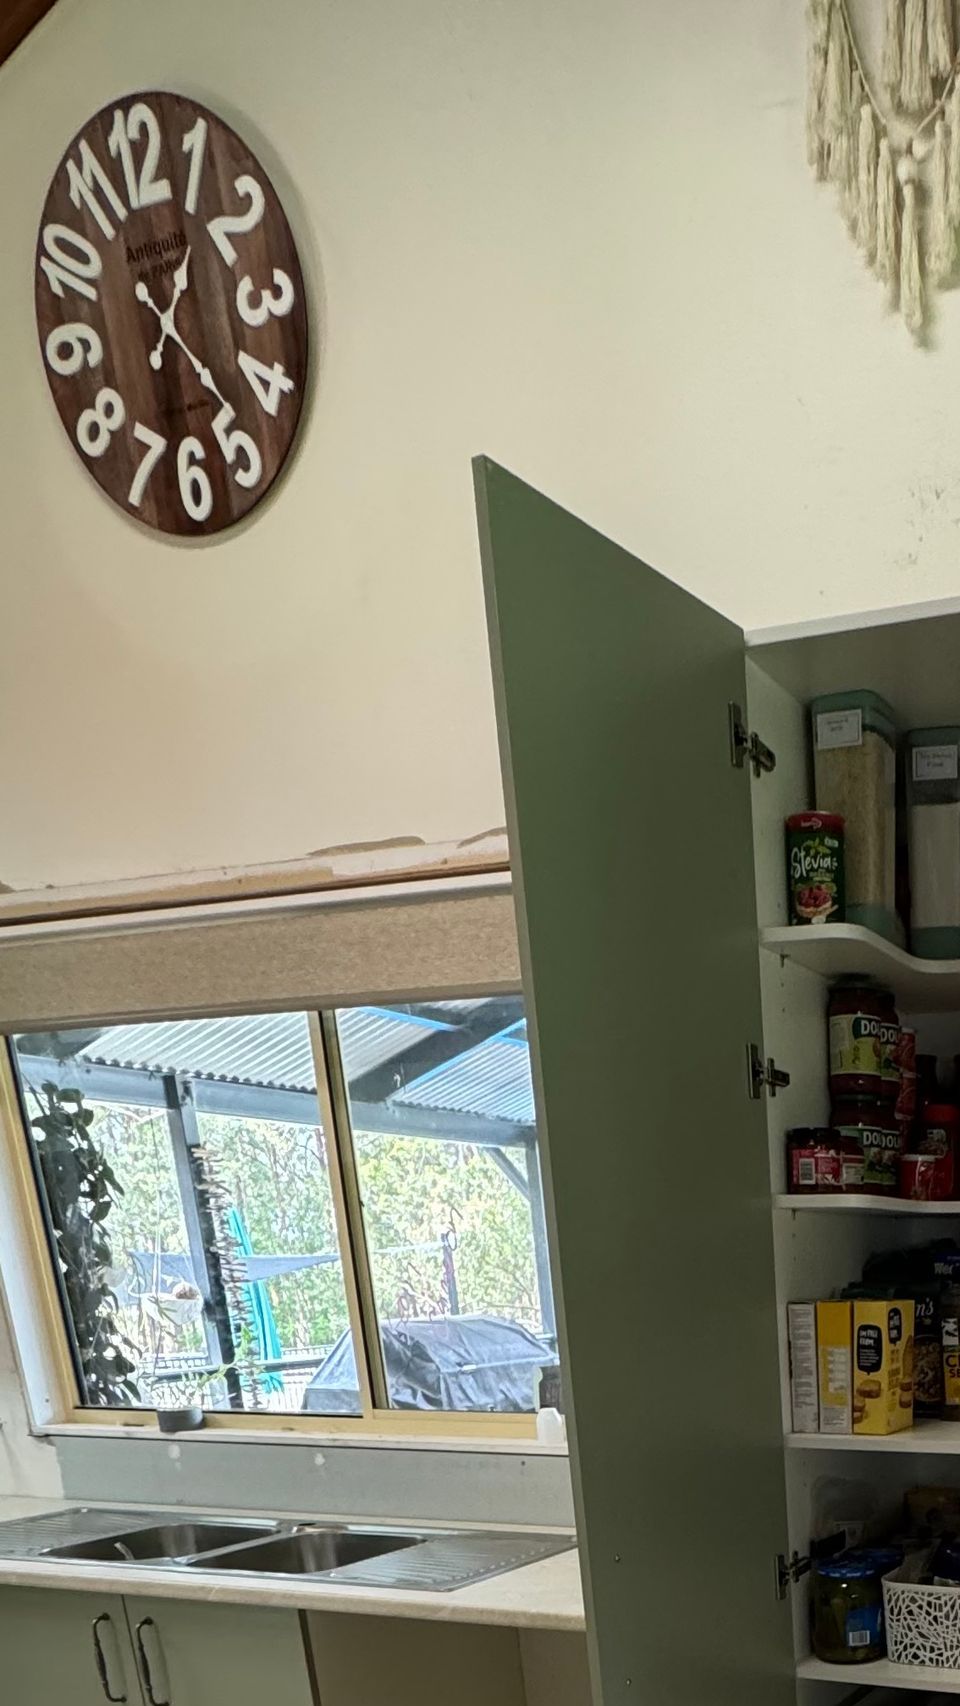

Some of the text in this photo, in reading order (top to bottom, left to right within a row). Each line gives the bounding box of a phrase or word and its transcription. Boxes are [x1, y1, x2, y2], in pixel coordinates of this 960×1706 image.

[66, 138, 128, 241] 11
[108, 102, 173, 208] 12
[182, 117, 208, 215] 1
[39, 223, 103, 303] 10
[206, 175, 265, 267] 2
[236, 269, 295, 328] 3
[45, 322, 104, 377] 9
[237, 350, 295, 417] 4
[76, 386, 126, 458] 8
[211, 405, 262, 489] 5
[128, 422, 168, 508] 7
[176, 435, 213, 522] 6
[791, 842, 832, 879] Stevia
